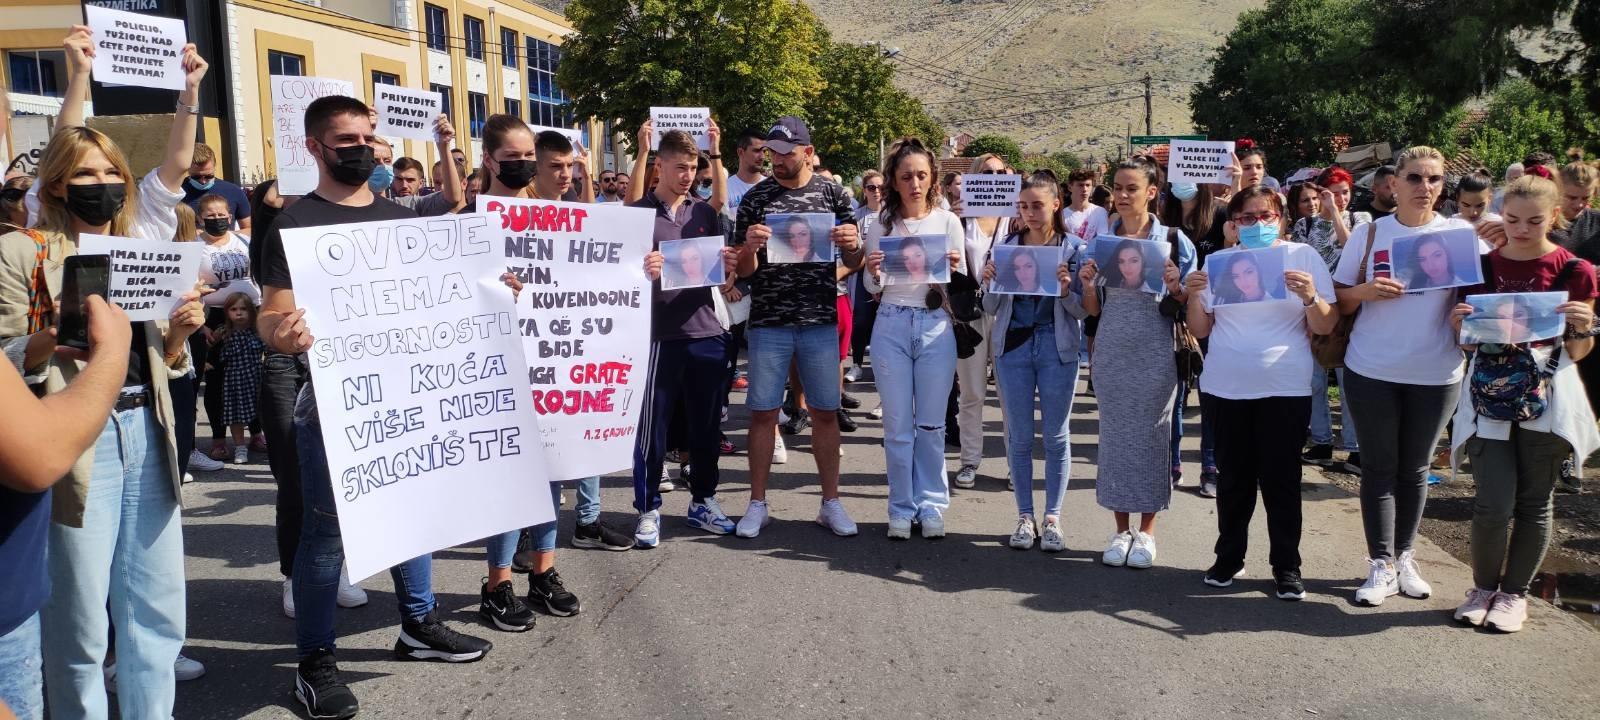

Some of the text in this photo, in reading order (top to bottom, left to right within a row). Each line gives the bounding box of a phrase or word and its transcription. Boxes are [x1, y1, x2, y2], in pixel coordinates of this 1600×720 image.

[115, 20, 162, 34] POLICIJO,
[105, 30, 173, 46] TUŽIOCI, KAD
[126, 44, 160, 55] POČETI
[112, 54, 164, 67] VJERUJETE
[112, 64, 164, 78] ŽRTVAMA?
[381, 92, 436, 107] PRIVEDITE
[387, 106, 428, 118] PRAVDI
[388, 118, 424, 129] UBICU!
[487, 201, 588, 232] BURRAT
[110, 250, 137, 260] IMA
[141, 252, 154, 261] LI
[315, 216, 491, 277] OVDJE
[505, 233, 554, 260] NËN
[111, 264, 181, 274] LEMENATA
[215, 267, 248, 281] YEAH
[507, 263, 559, 288] ZIN,
[331, 272, 472, 322] NEMA
[532, 287, 640, 309] KUVENDOJNË
[549, 315, 572, 336] QË
[314, 311, 512, 369] SIGURNOSTI
[538, 339, 584, 359] BIJE
[342, 352, 507, 410] NI KUĆA
[345, 388, 516, 452] VIŠE NIJE
